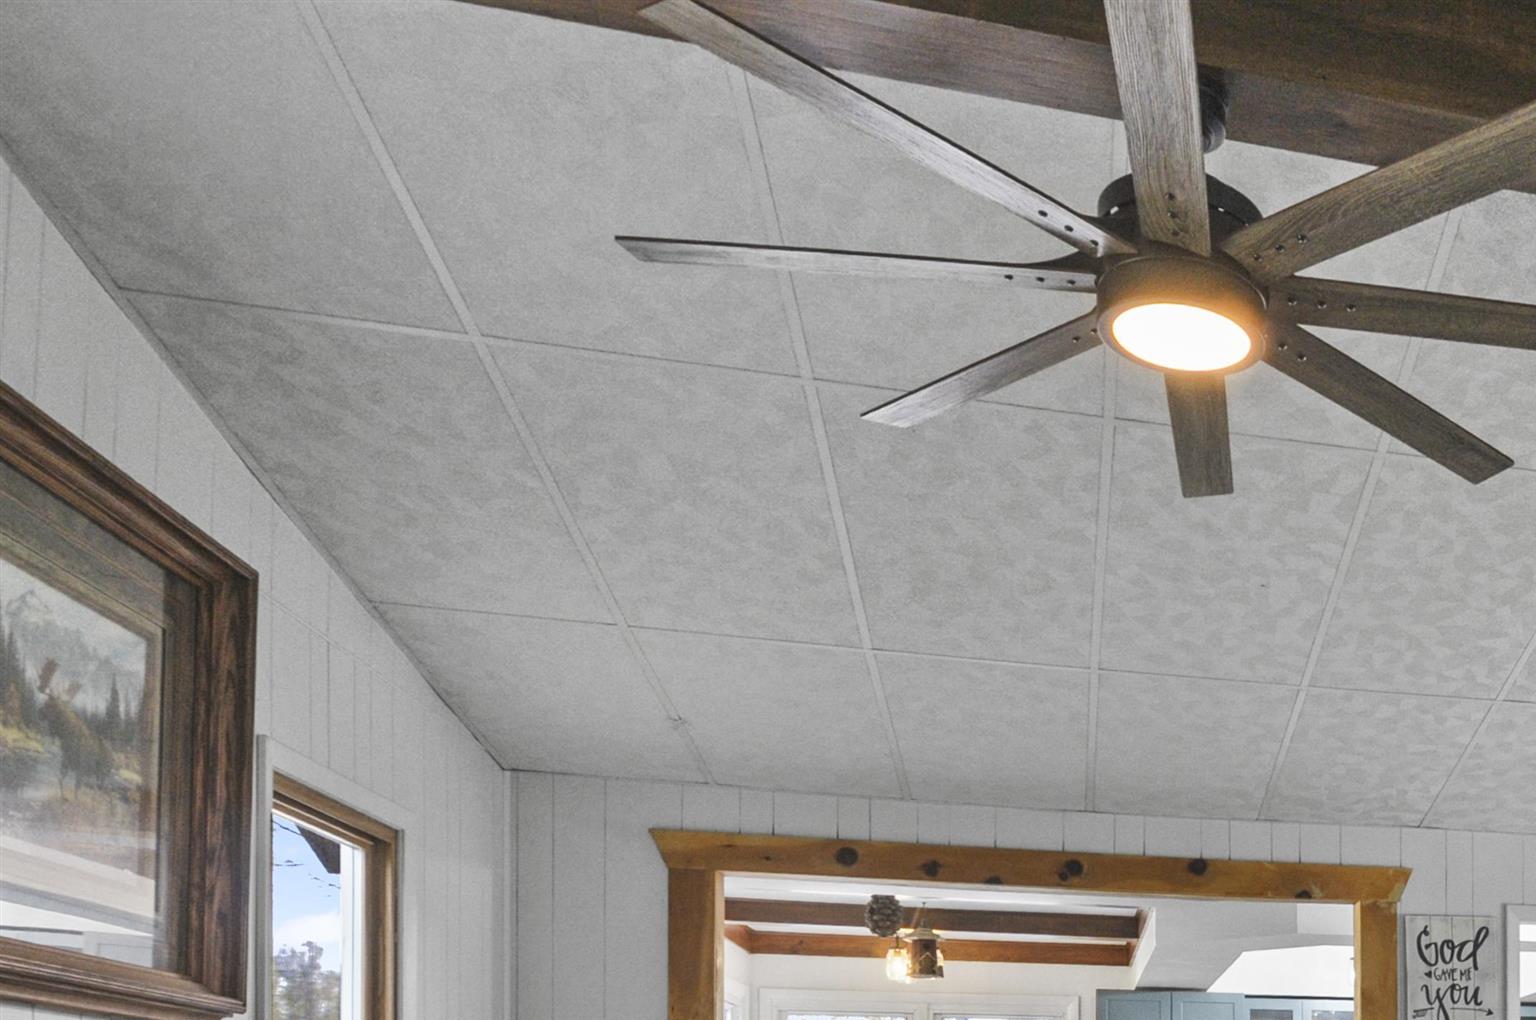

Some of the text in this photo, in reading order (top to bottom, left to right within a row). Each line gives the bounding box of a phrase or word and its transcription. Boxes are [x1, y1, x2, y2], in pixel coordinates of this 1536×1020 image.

[1416, 925, 1490, 971] God
[1433, 967, 1473, 982] GAVE ME
